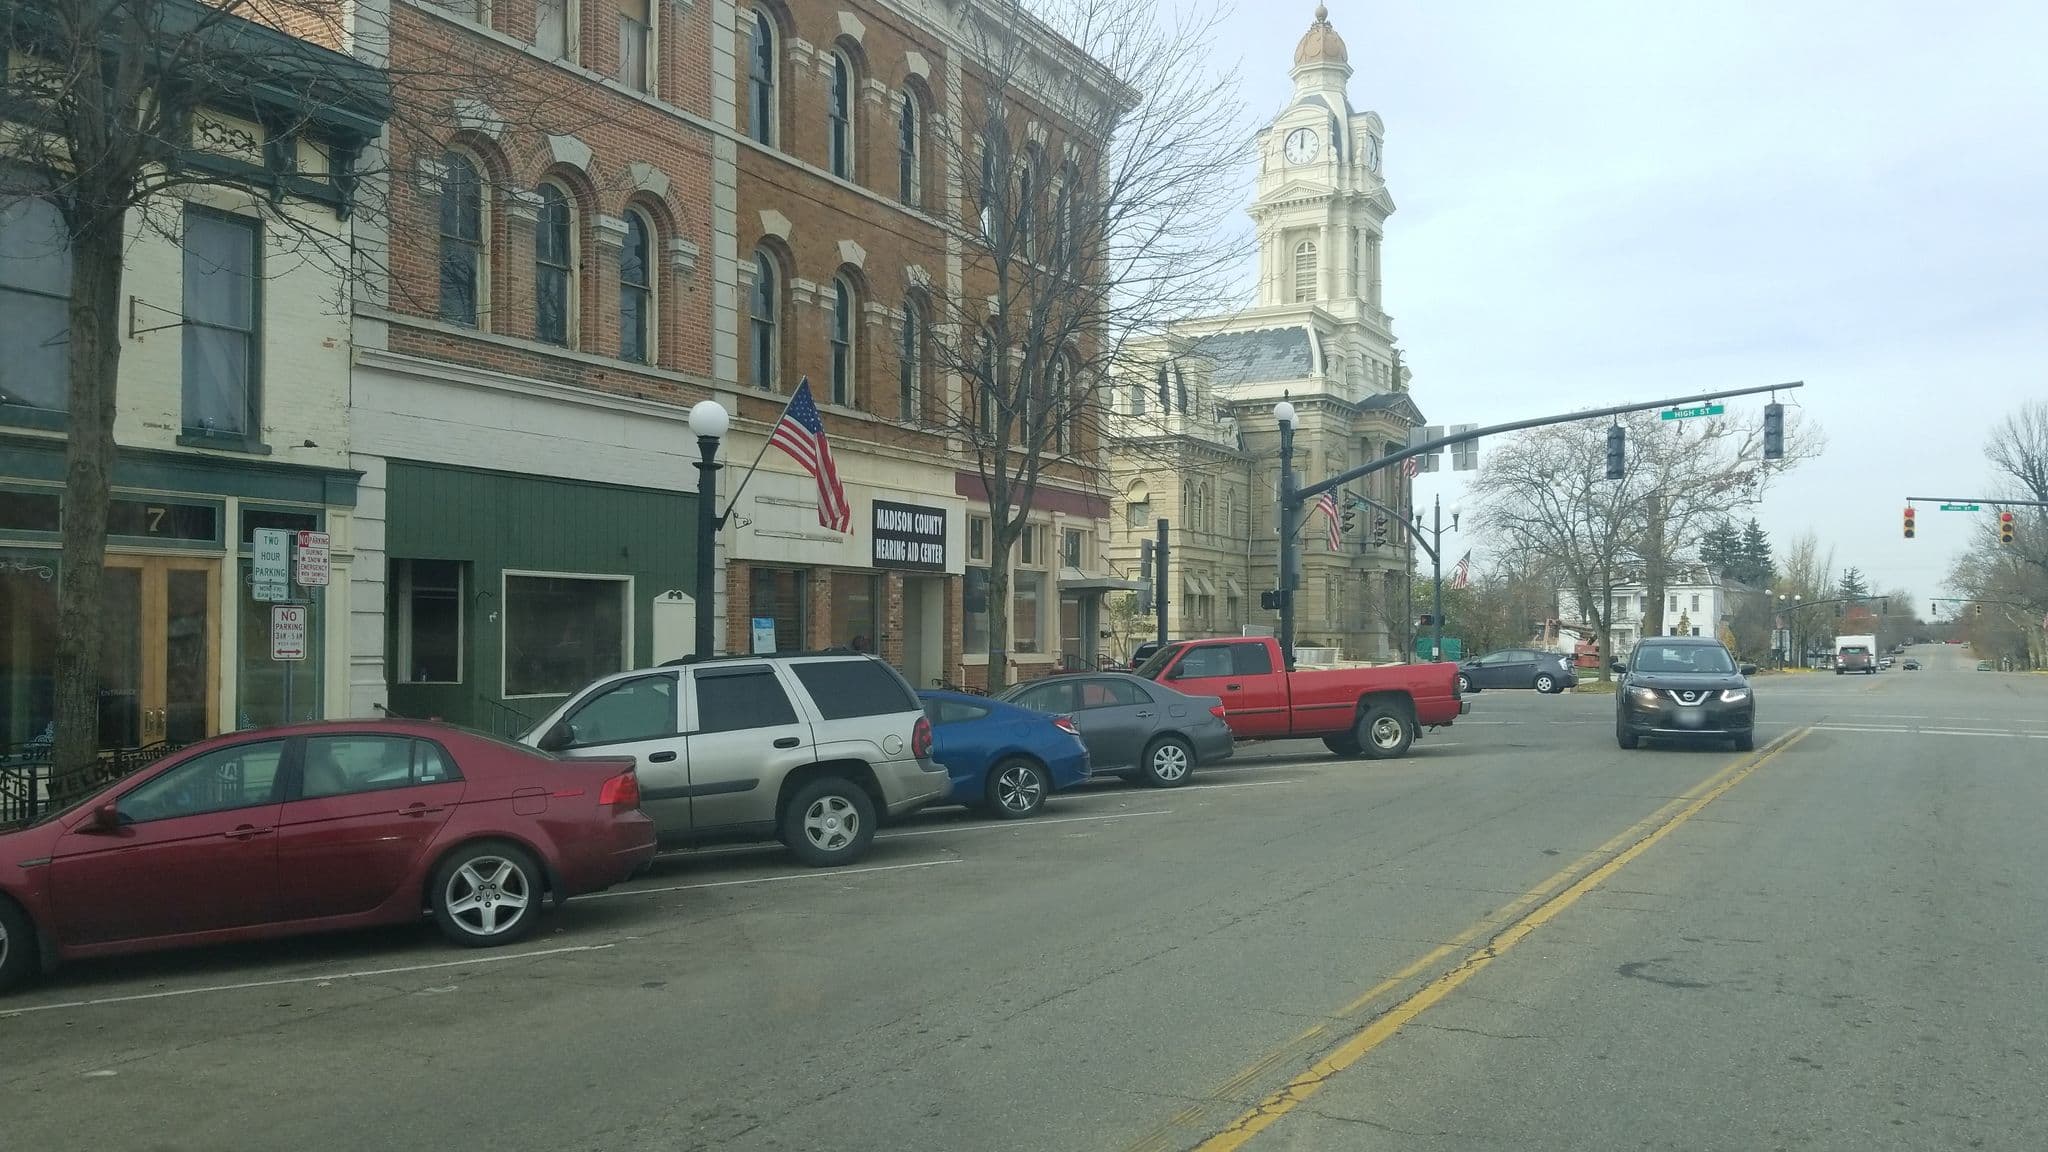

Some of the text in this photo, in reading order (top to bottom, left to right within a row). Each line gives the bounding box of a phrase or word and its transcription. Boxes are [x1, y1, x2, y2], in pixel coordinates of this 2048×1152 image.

[1674, 407, 1711, 418] HIGH ST
[147, 508, 166, 532] 7
[876, 508, 943, 536] MADISON COUNTY
[264, 535, 279, 546] TWO
[300, 533, 329, 546] NO PARKING
[261, 551, 281, 561] HOUR
[876, 538, 943, 564] HEARING AID CENTER
[255, 567, 286, 577] PARKING
[281, 610, 297, 621] NO
[275, 623, 303, 631] PARKING
